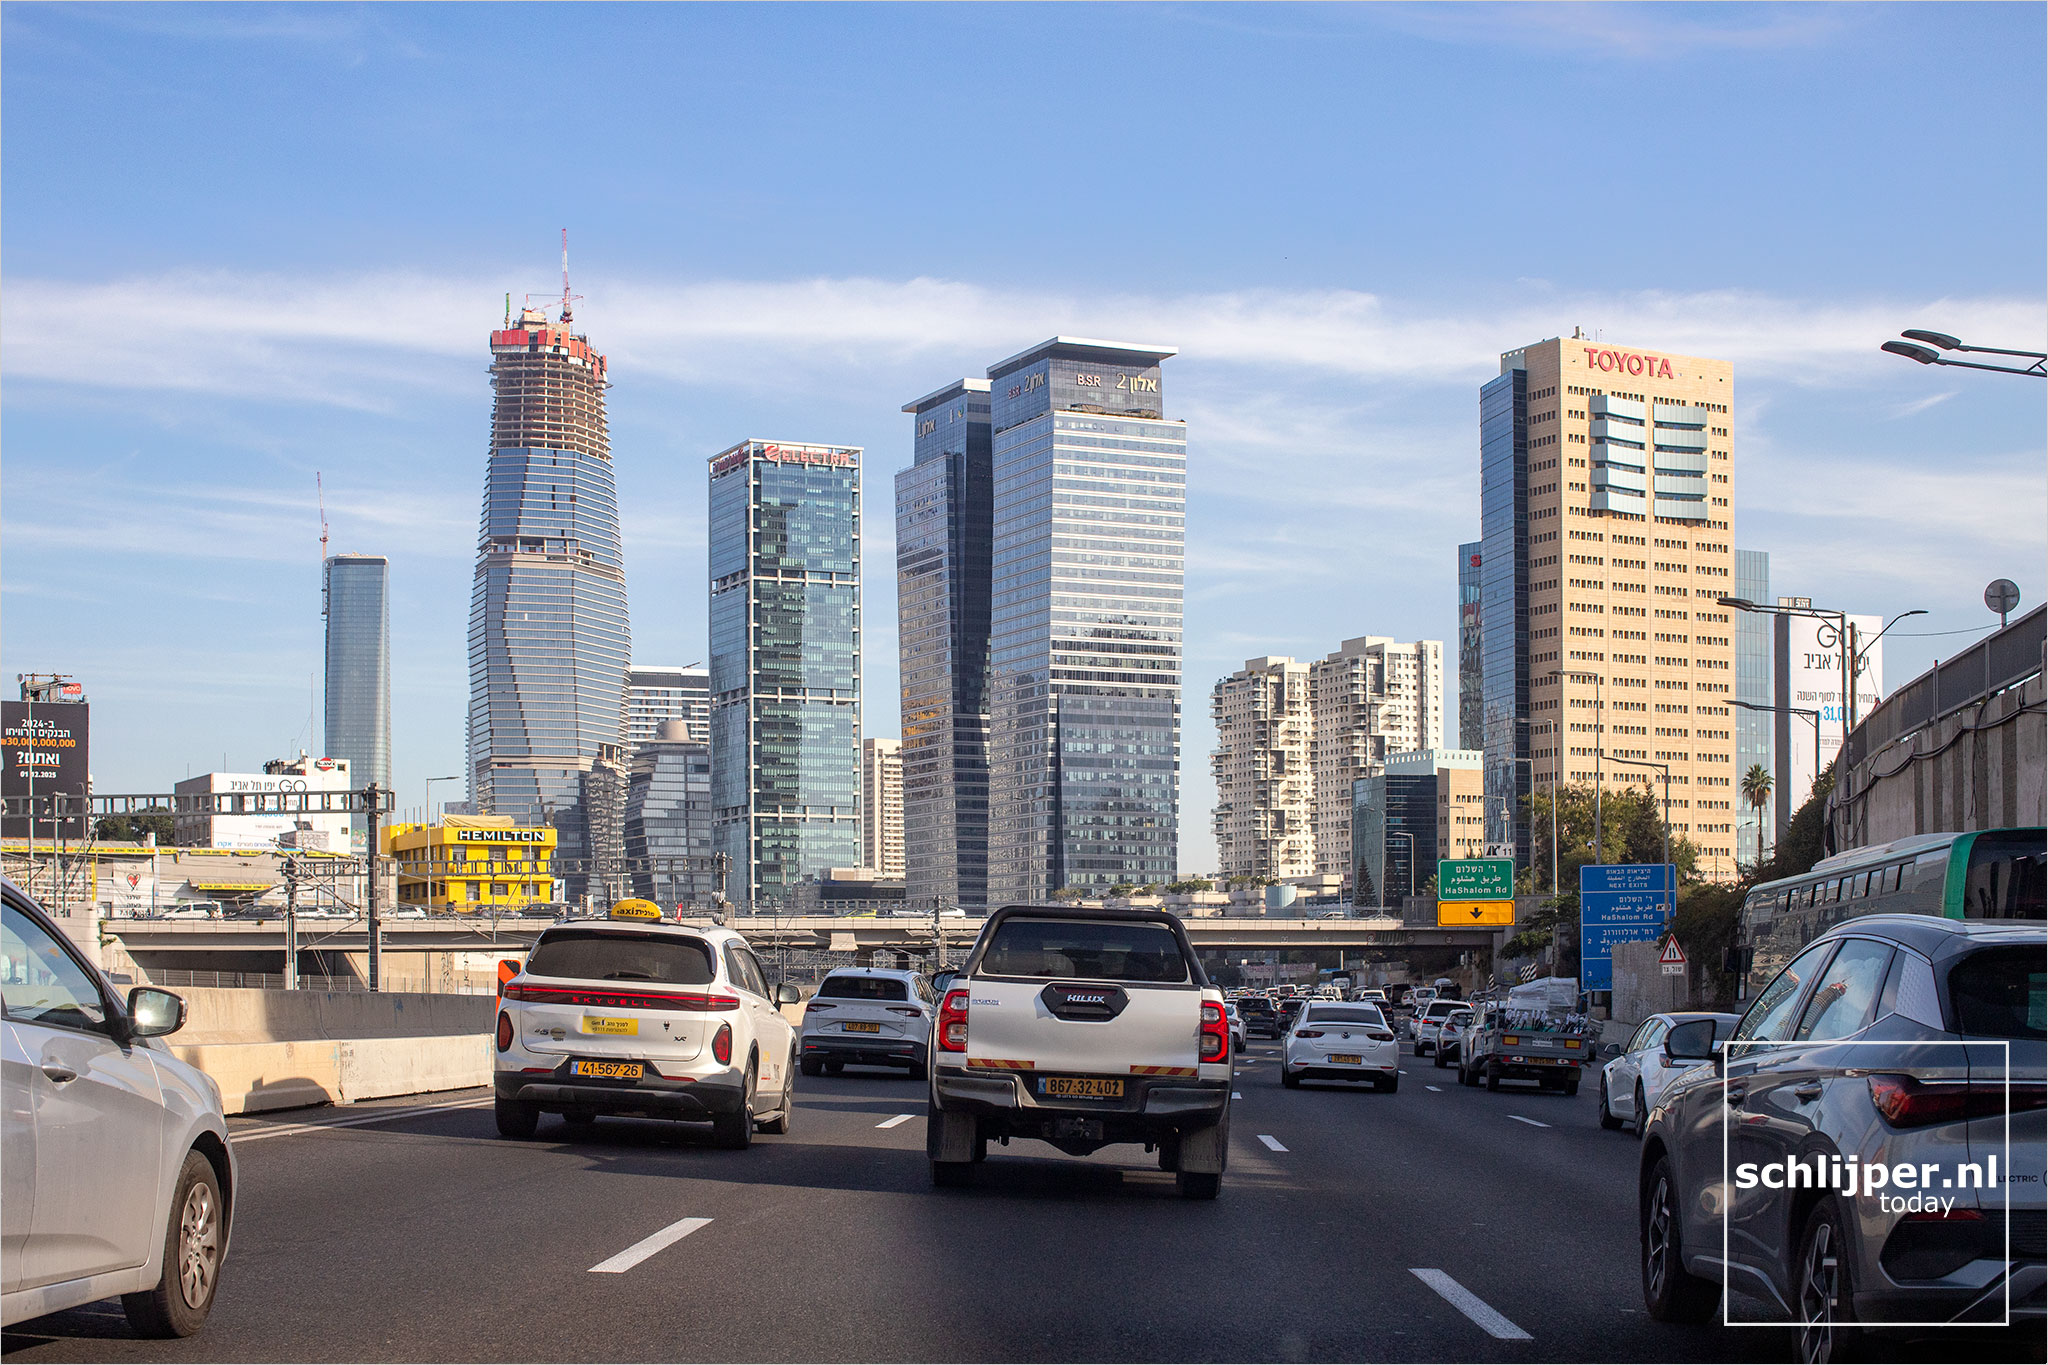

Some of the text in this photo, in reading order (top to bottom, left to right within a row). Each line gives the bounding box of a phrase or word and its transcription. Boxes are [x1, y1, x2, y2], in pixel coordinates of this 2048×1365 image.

[1584, 347, 1674, 379] TOYOTA
[1024, 375, 1030, 392] 2
[1115, 372, 1158, 394] אלון 2
[782, 449, 850, 466] ELECTRA
[1804, 653, 1831, 670] אביב
[1797, 690, 1817, 701] השנה
[1819, 691, 1836, 704] לסוף
[5, 727, 70, 739] הבנקים הרוויחו
[16, 751, 60, 765] ואתם?
[230, 780, 249, 791] אביב
[250, 780, 262, 791] תל
[279, 779, 307, 793] GO
[458, 830, 545, 842] HEMILTON
[1503, 847, 1512, 856] 11
[1455, 865, 1484, 873] השלום
[1480, 875, 1502, 885] طريق
[1495, 886, 1507, 894] Rd
[635, 909, 655, 917] מונית
[572, 996, 651, 1007] SKYWELL
[1066, 994, 1105, 1004] HILUX
[1996, 1174, 2039, 1183] LECTRIC
